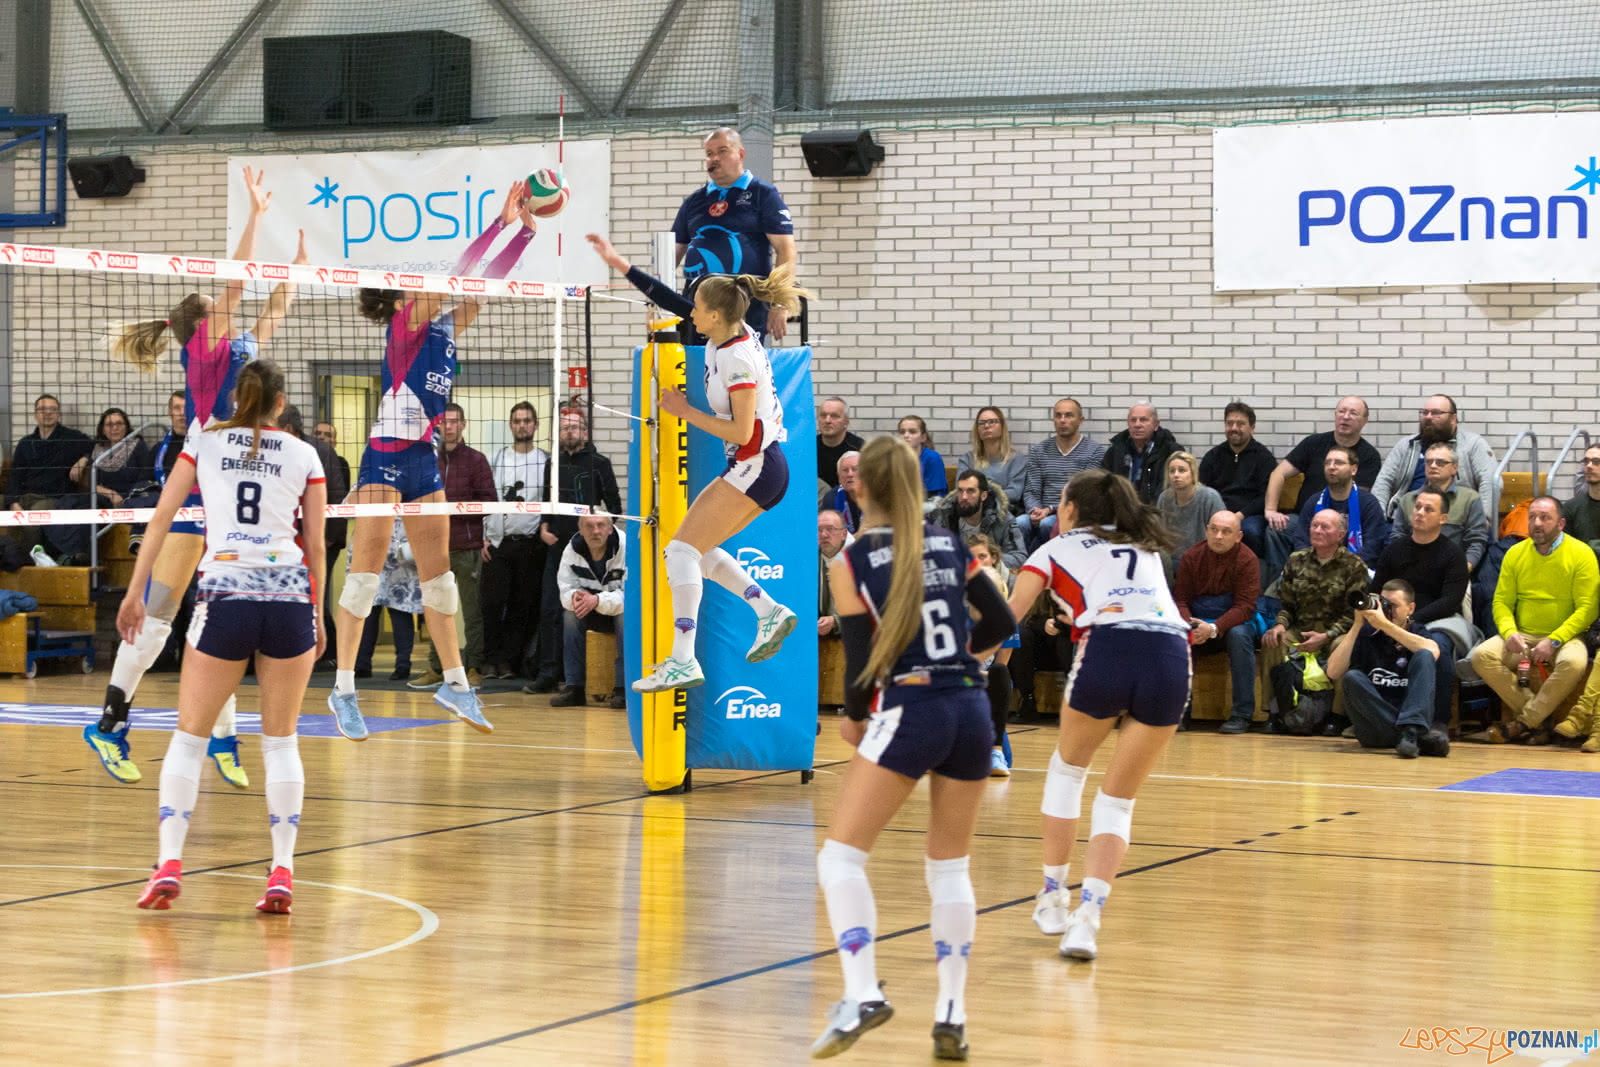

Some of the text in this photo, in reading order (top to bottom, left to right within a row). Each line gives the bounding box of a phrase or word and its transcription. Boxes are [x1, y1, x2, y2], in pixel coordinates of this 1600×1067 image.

[187, 260, 216, 274] ORLEN
[333, 270, 358, 283] ORLEN
[227, 433, 282, 451] PASNIK
[221, 457, 282, 477] ENERGETYK
[236, 481, 262, 525] 8
[1111, 549, 1138, 580] 7
[921, 599, 958, 660] 6
[1372, 673, 1409, 687] Enea
[726, 699, 782, 719] Enea
